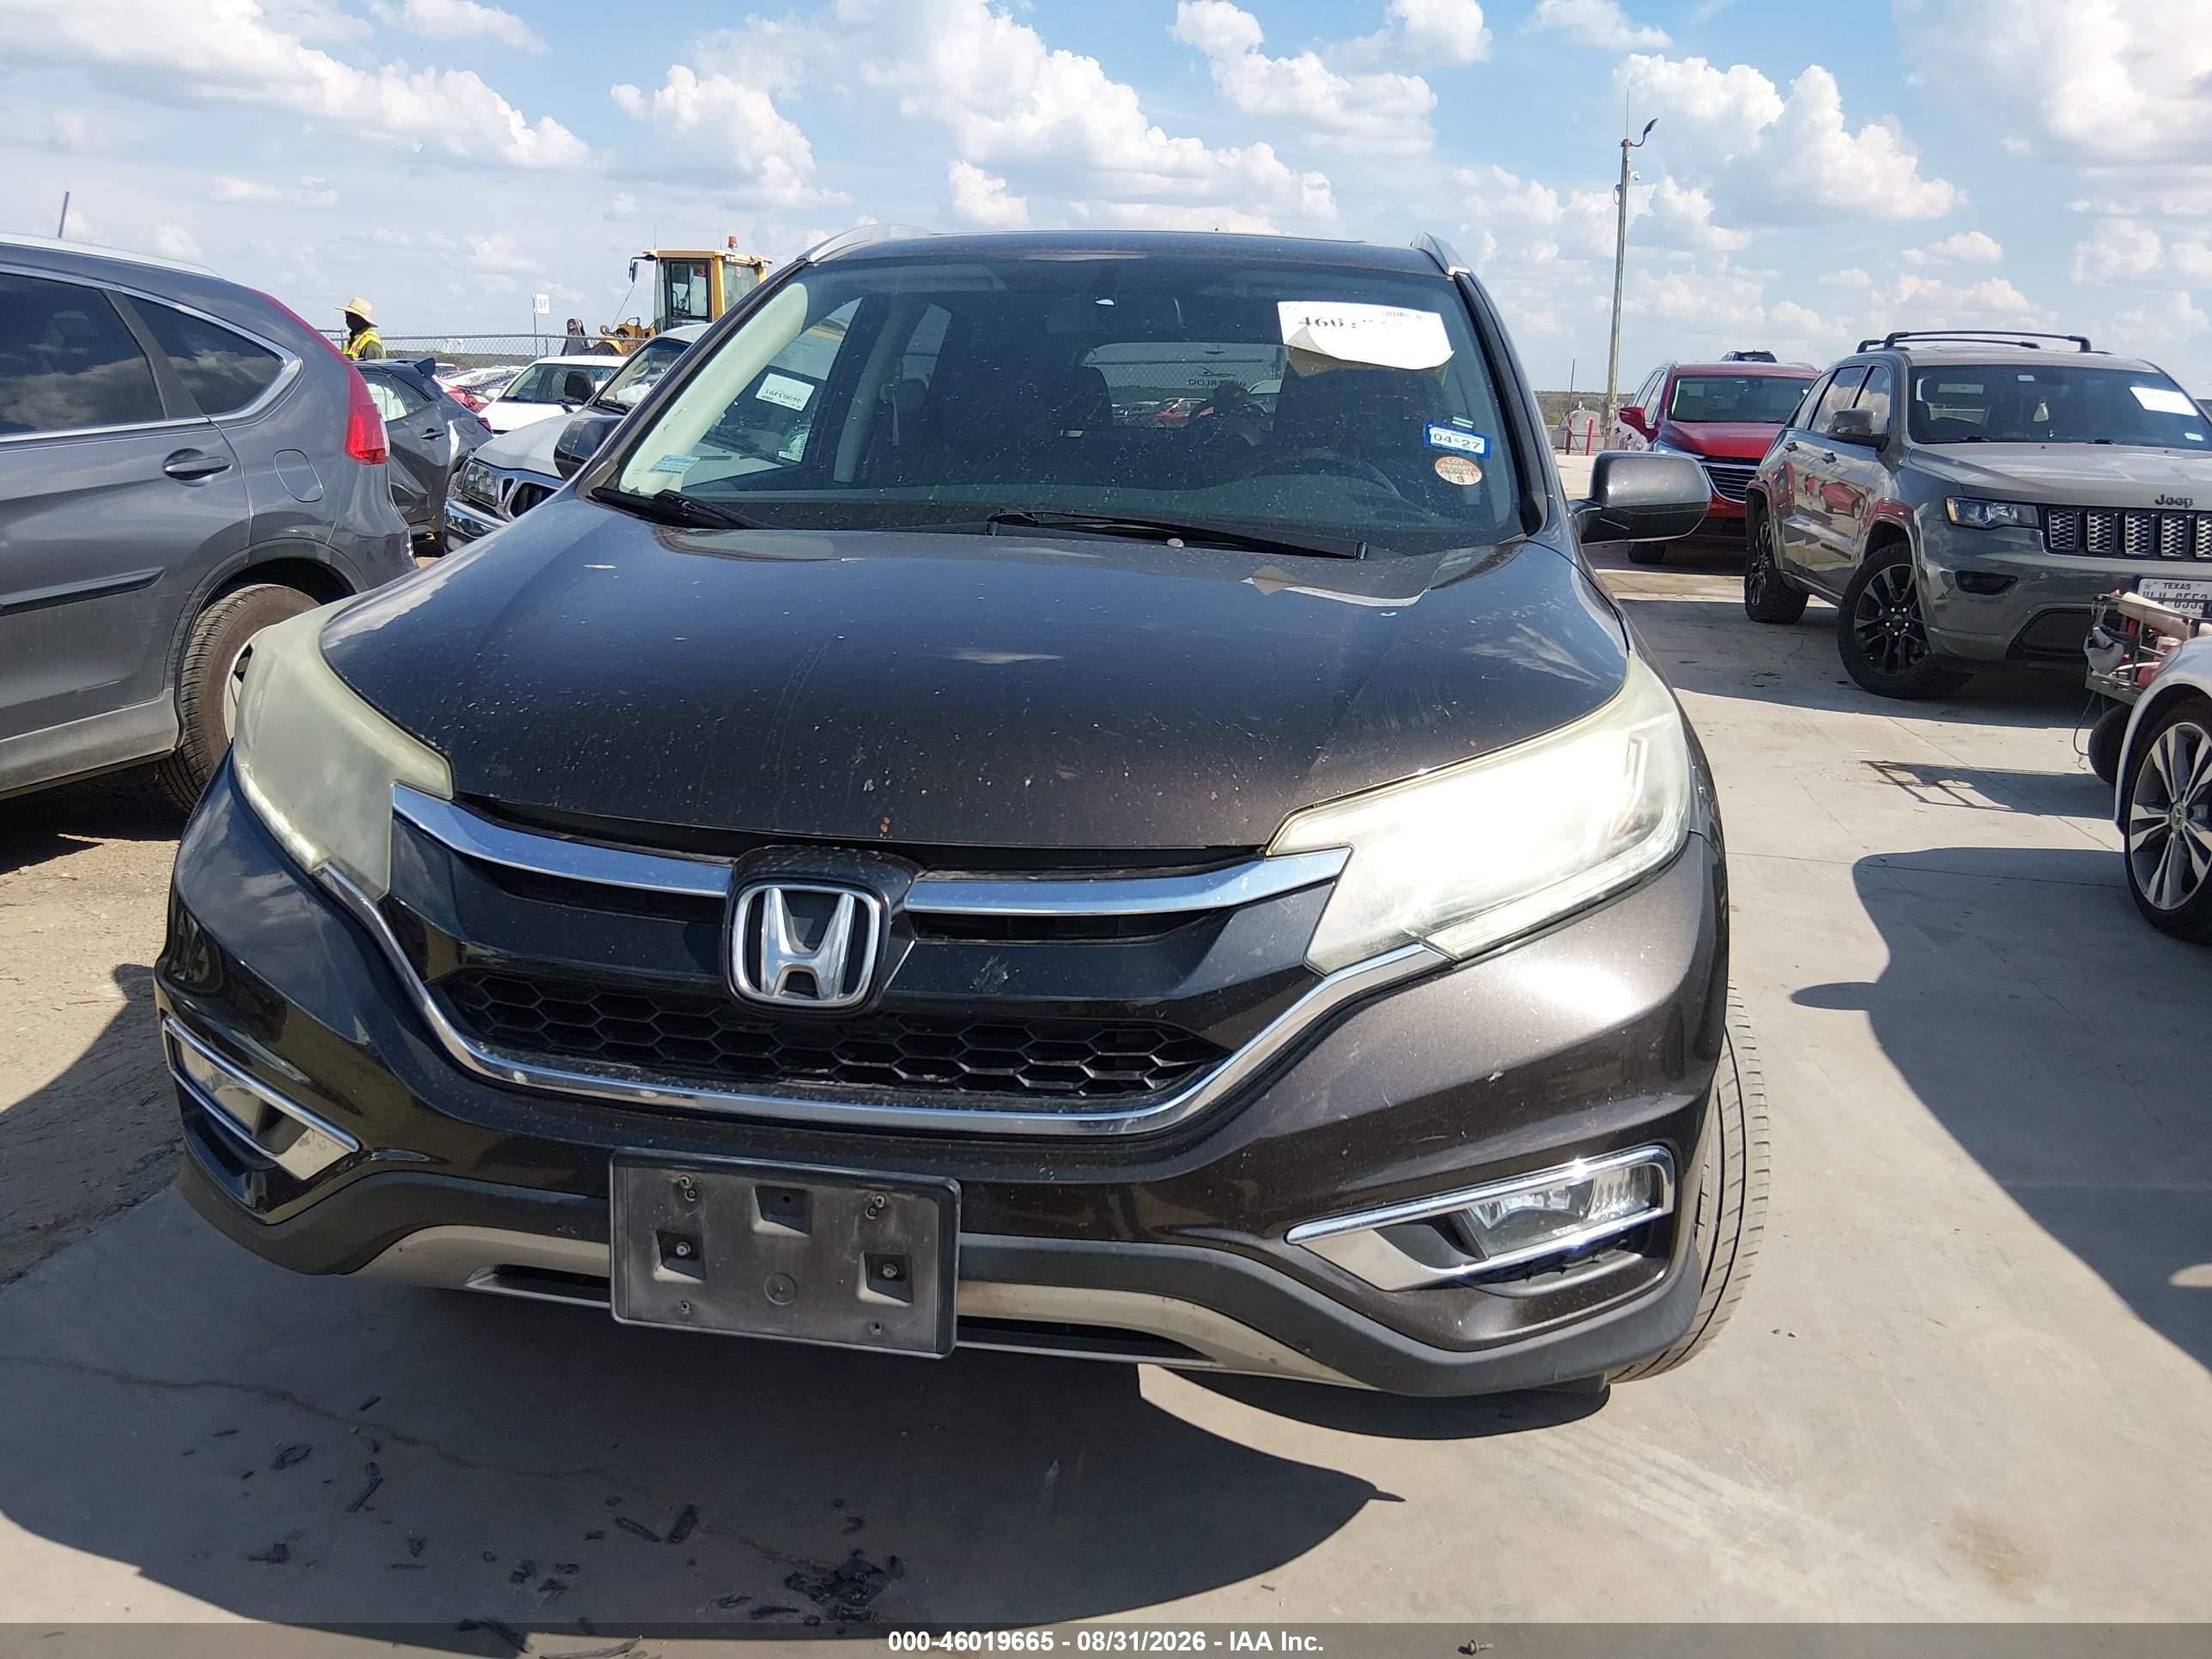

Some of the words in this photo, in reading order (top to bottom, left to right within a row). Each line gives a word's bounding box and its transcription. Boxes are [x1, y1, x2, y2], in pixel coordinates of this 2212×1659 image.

[538, 298, 548, 310] SF
[1434, 433, 1451, 444] 04
[1462, 439, 1480, 449] 27
[2154, 494, 2194, 508] Jeep
[2162, 581, 2191, 590] TEXAS
